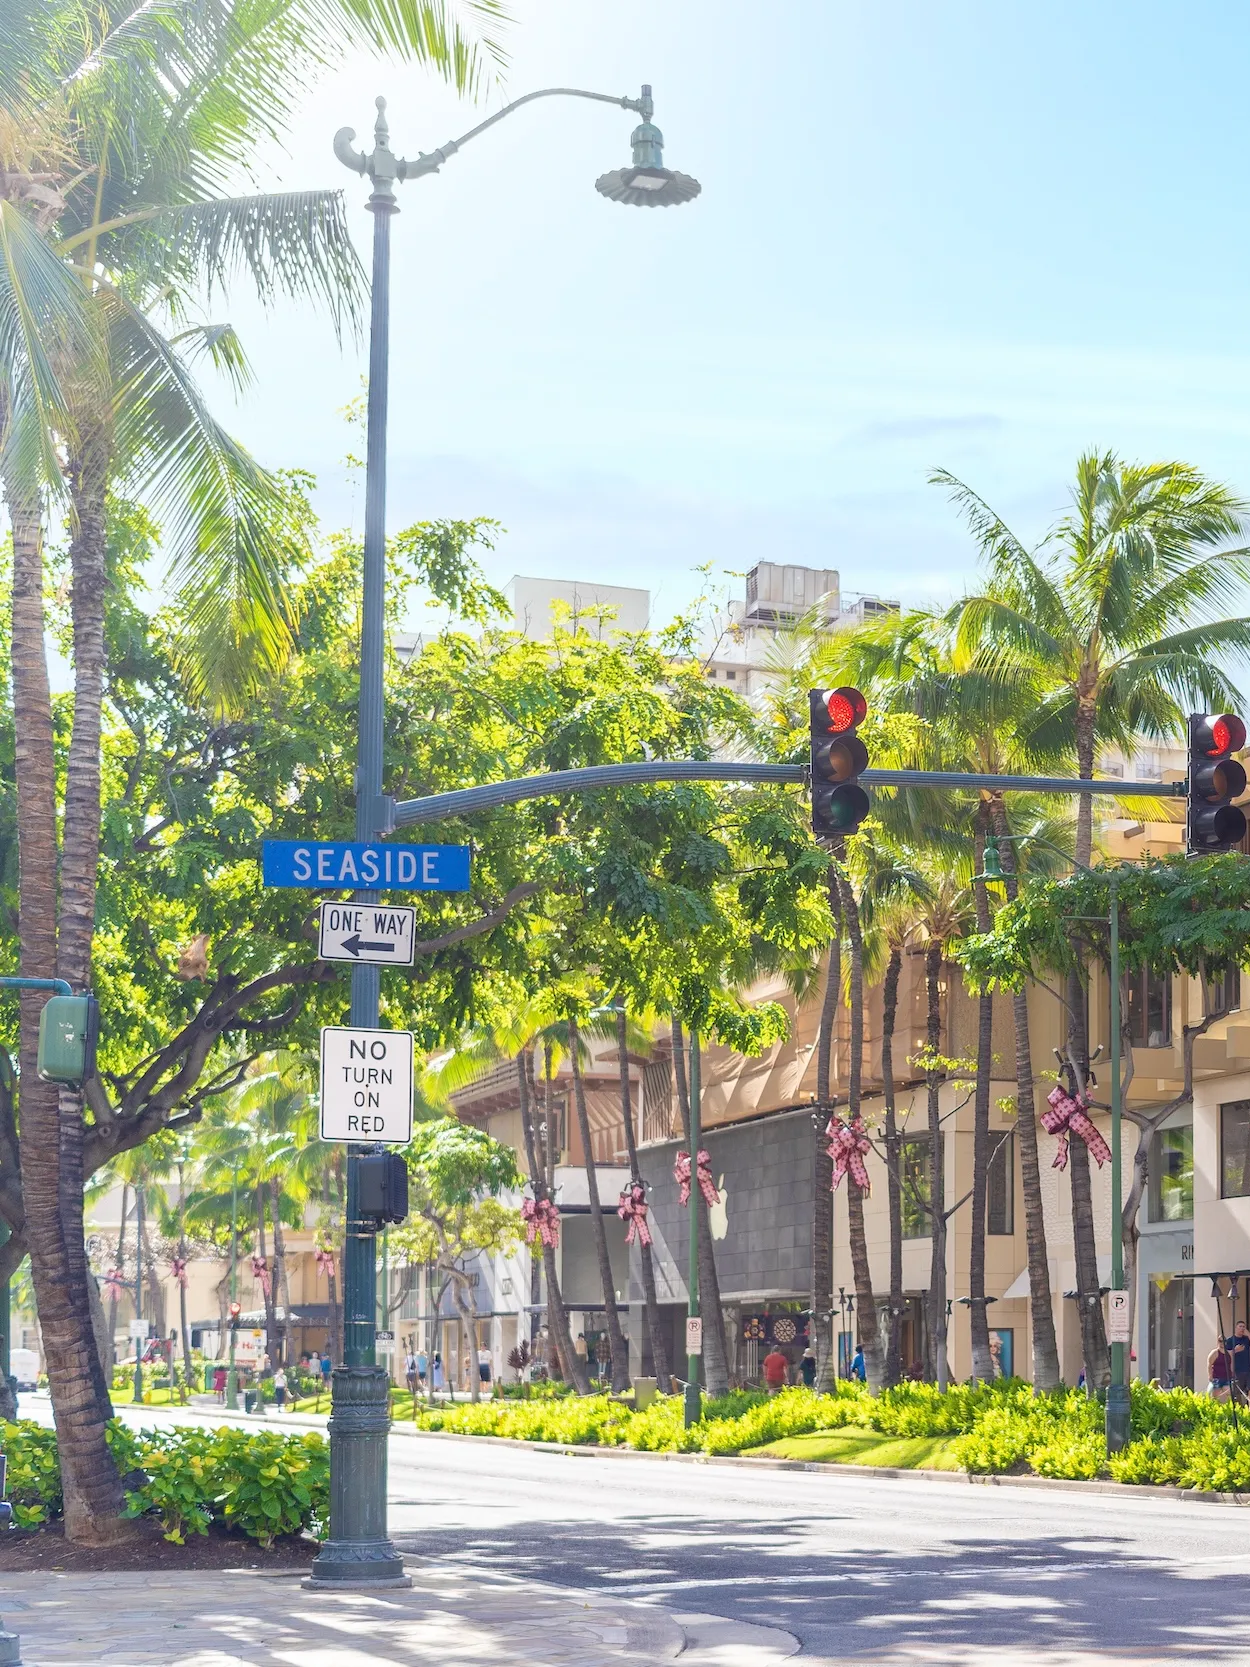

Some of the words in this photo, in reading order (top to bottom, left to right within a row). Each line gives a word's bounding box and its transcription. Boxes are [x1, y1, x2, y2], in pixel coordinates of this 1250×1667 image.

[293, 848, 440, 884] SEASIDE
[330, 909, 363, 932] ONE
[374, 913, 407, 936] WAY
[350, 1039, 387, 1061] NO
[342, 1066, 393, 1085] TURN
[354, 1091, 380, 1108] ON
[348, 1115, 385, 1133] RED
[1181, 1244, 1194, 1260] RI
